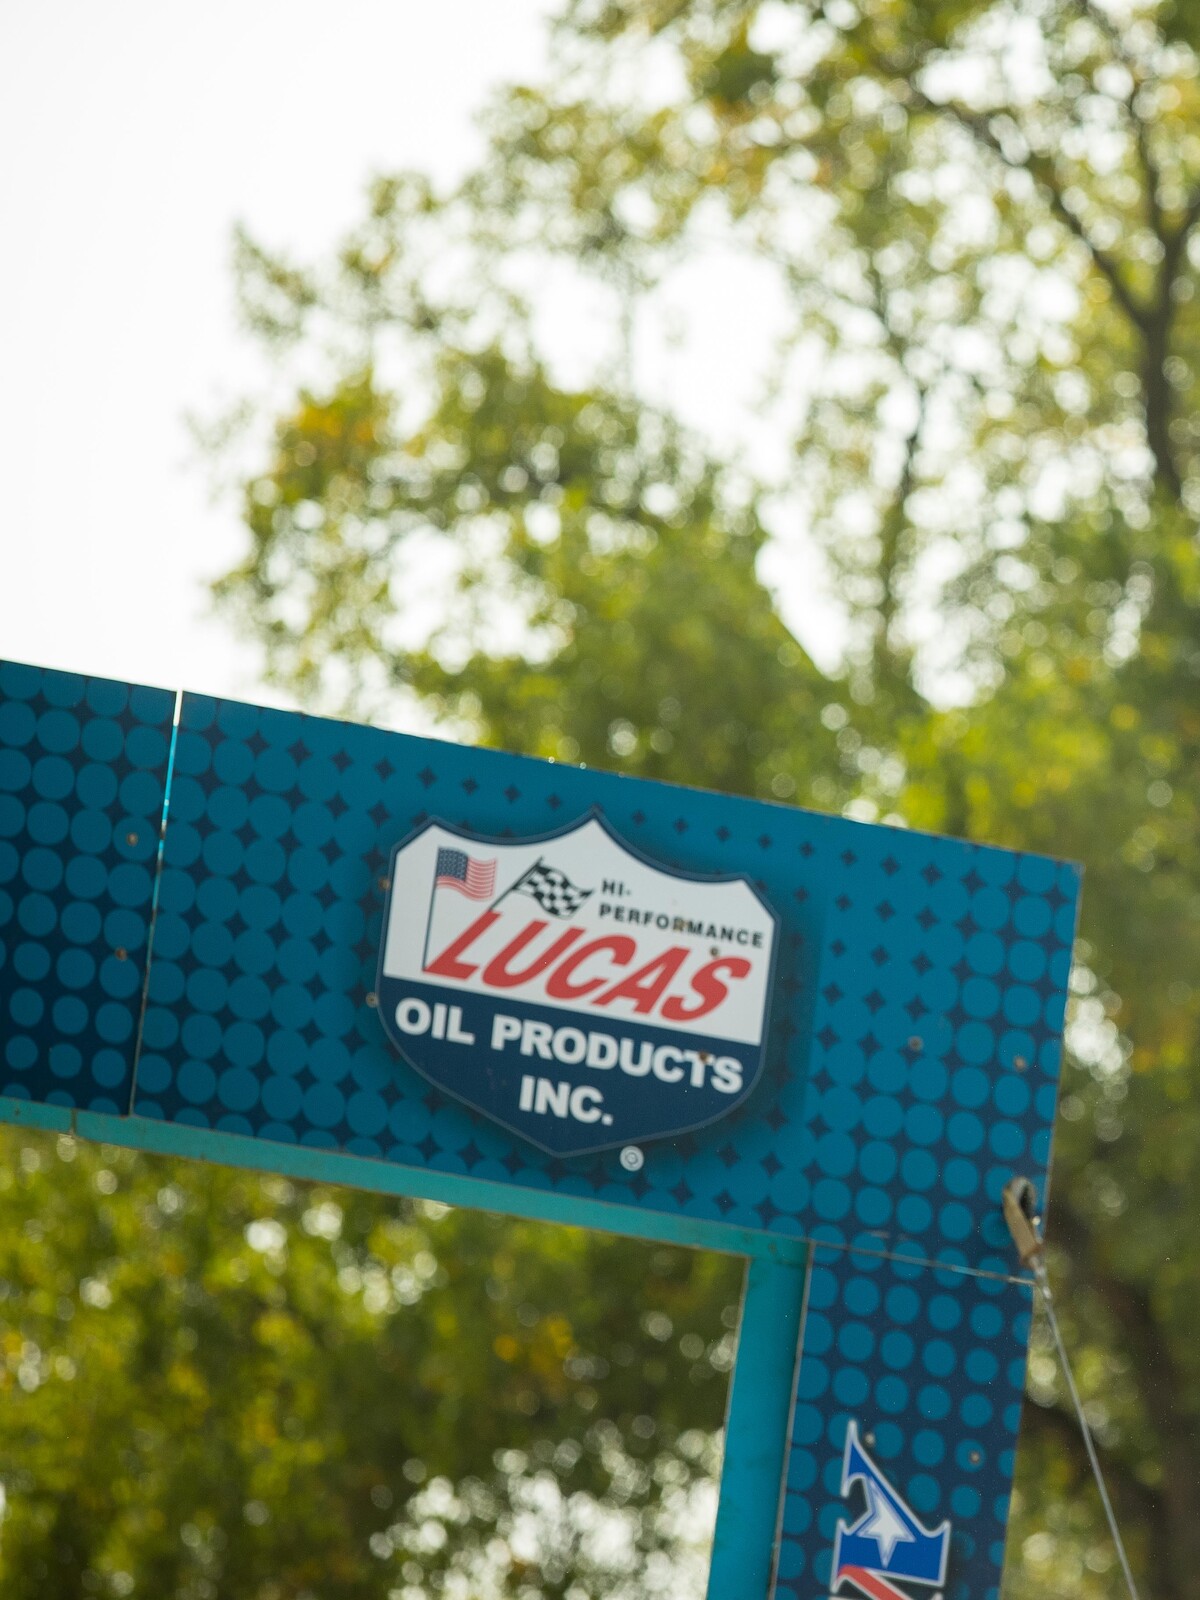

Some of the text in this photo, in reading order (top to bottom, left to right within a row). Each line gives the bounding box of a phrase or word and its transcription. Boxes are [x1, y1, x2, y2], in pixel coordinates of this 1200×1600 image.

[601, 878, 632, 898] HI-
[598, 902, 764, 949] PERFORMANCE
[423, 909, 752, 1023] LUCAS
[394, 997, 743, 1095] OIL PRODUCTS
[518, 1075, 614, 1126] INC.
